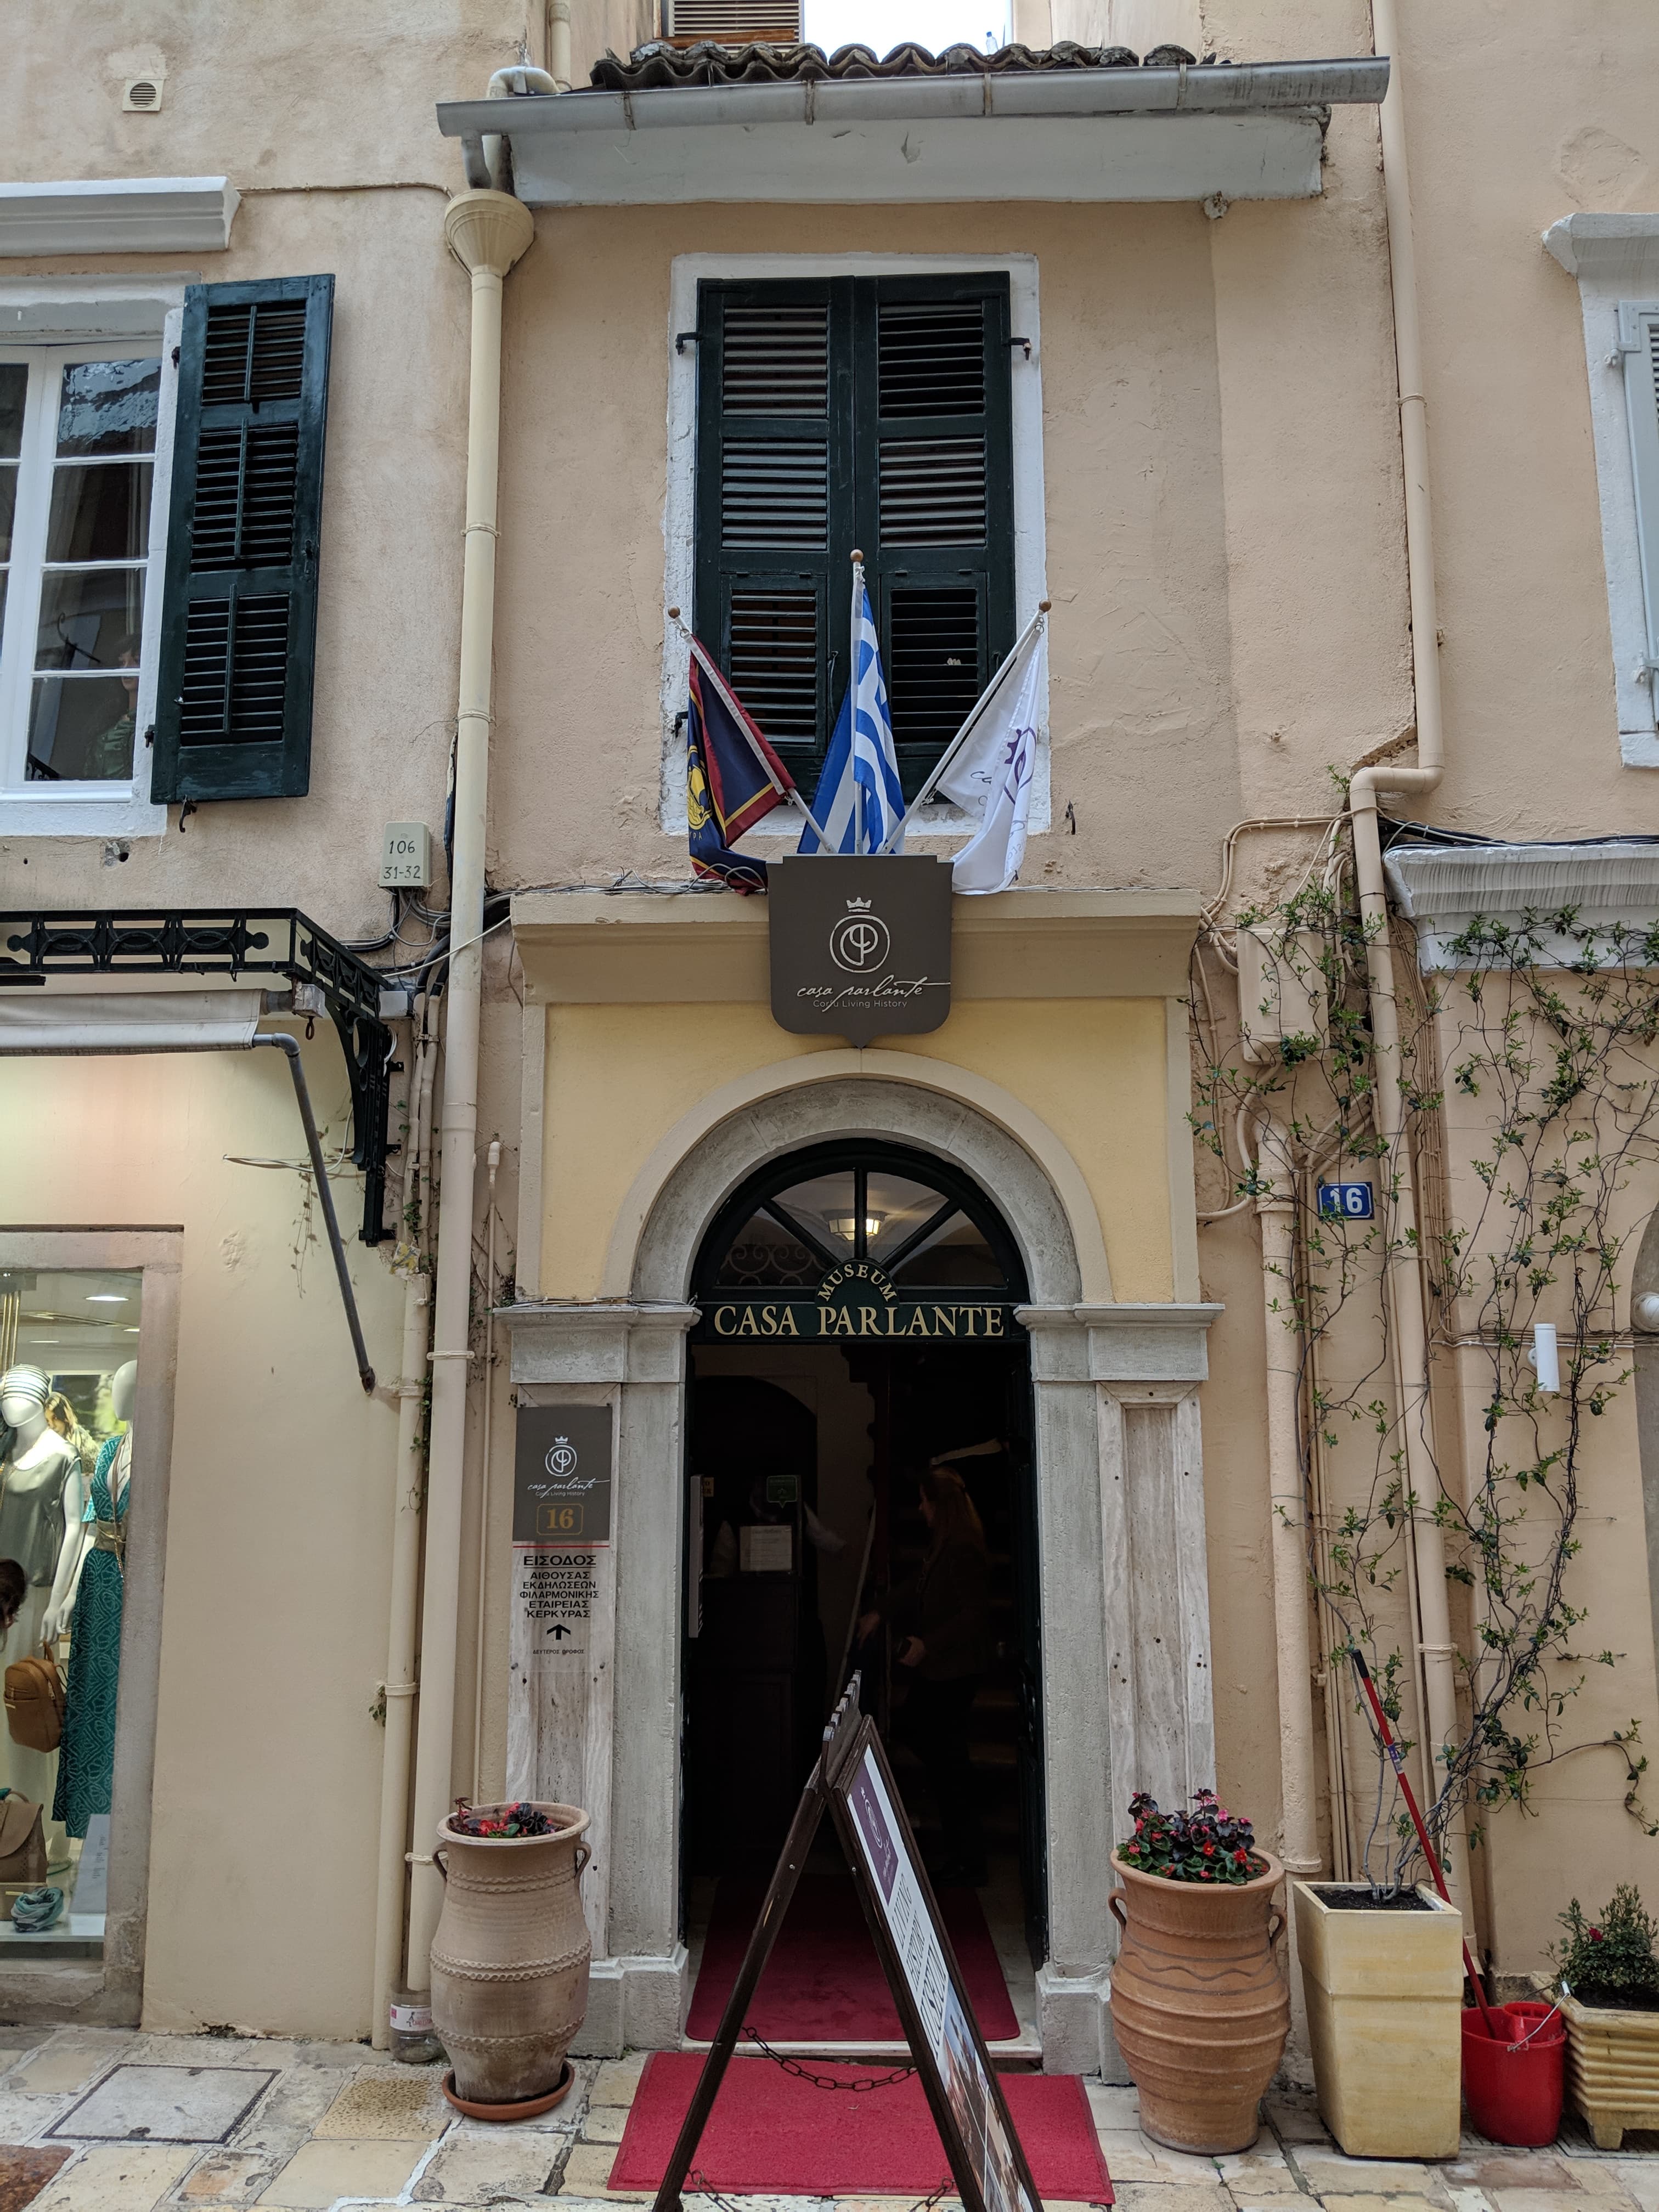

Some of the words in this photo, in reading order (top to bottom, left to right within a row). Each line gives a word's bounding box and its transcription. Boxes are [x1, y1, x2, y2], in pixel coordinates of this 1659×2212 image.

[388, 840, 416, 854] 106
[383, 865, 421, 879] 31-32
[797, 986, 833, 998] casa
[822, 974, 951, 1013] parlante
[813, 1000, 839, 1008] Corfu
[842, 1000, 871, 1008] Living
[874, 1000, 907, 1008] History
[1329, 1187, 1363, 1214] 16
[817, 1263, 898, 1302] MUSEUM
[714, 1305, 800, 1336] CASA
[816, 1305, 1005, 1336] PARLANTE
[546, 1508, 574, 1530] 16
[523, 1555, 597, 1566] ΕΙΣΟΔΟΣ
[530, 1571, 590, 1580] ΑΙΘΟΥΣΑΣ
[523, 1581, 596, 1590] ΕΚΔΗΛΩΣΕΩΝ
[520, 1590, 600, 1599] ΦΙΛΑΡΜΟΝΙΚΗΣ
[529, 1600, 589, 1609] ΕΤΑΙΡΕΙΑΣ
[527, 1610, 591, 1618] ΚΕΡΚΥΡΑΣ
[891, 1874, 912, 1950] LIVING
[906, 1910, 925, 1992] HISTORY
